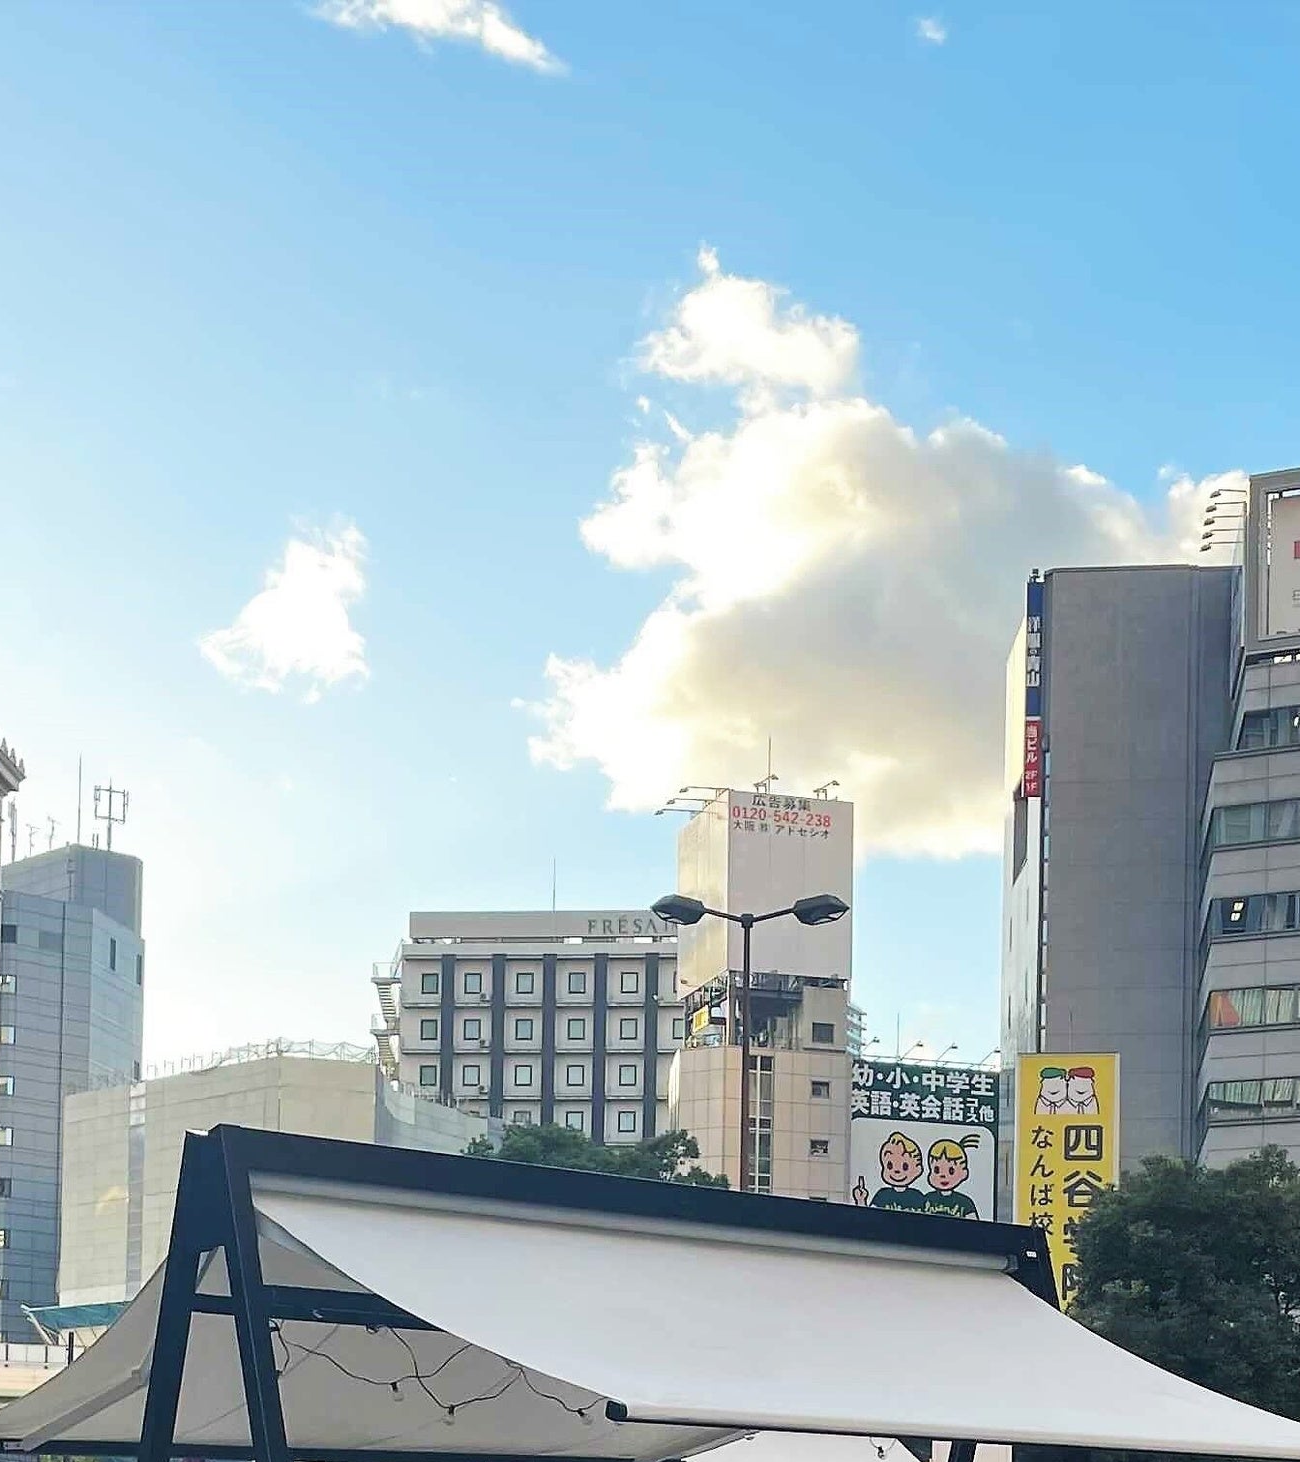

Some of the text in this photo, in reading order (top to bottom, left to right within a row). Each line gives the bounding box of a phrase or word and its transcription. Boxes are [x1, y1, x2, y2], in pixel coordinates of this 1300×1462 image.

[732, 805, 831, 828] 0120-542-238
[852, 1062, 995, 1097] 幼・小・中学生
[1029, 1125, 1055, 1236] なんば校
